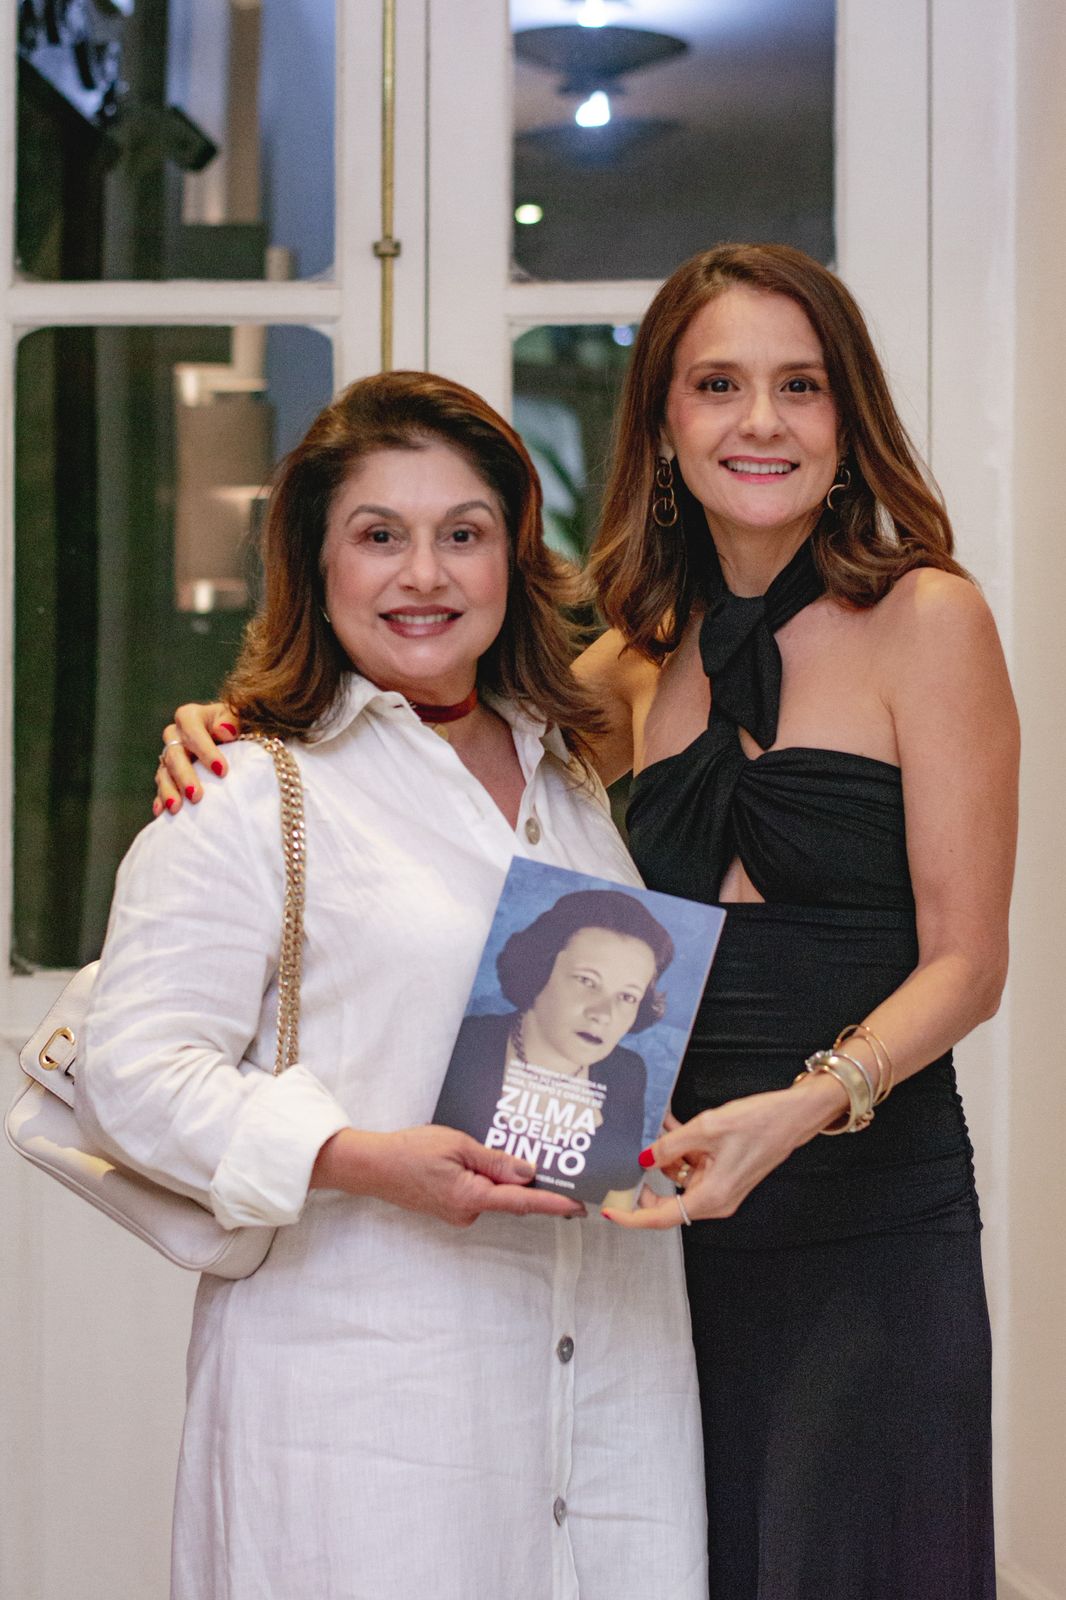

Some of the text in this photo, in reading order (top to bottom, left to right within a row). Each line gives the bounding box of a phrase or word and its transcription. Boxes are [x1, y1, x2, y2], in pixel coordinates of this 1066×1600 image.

[493, 1110, 592, 1153] COELHO
[496, 1085, 596, 1136] ZILMA
[484, 1126, 586, 1177] PINTO
